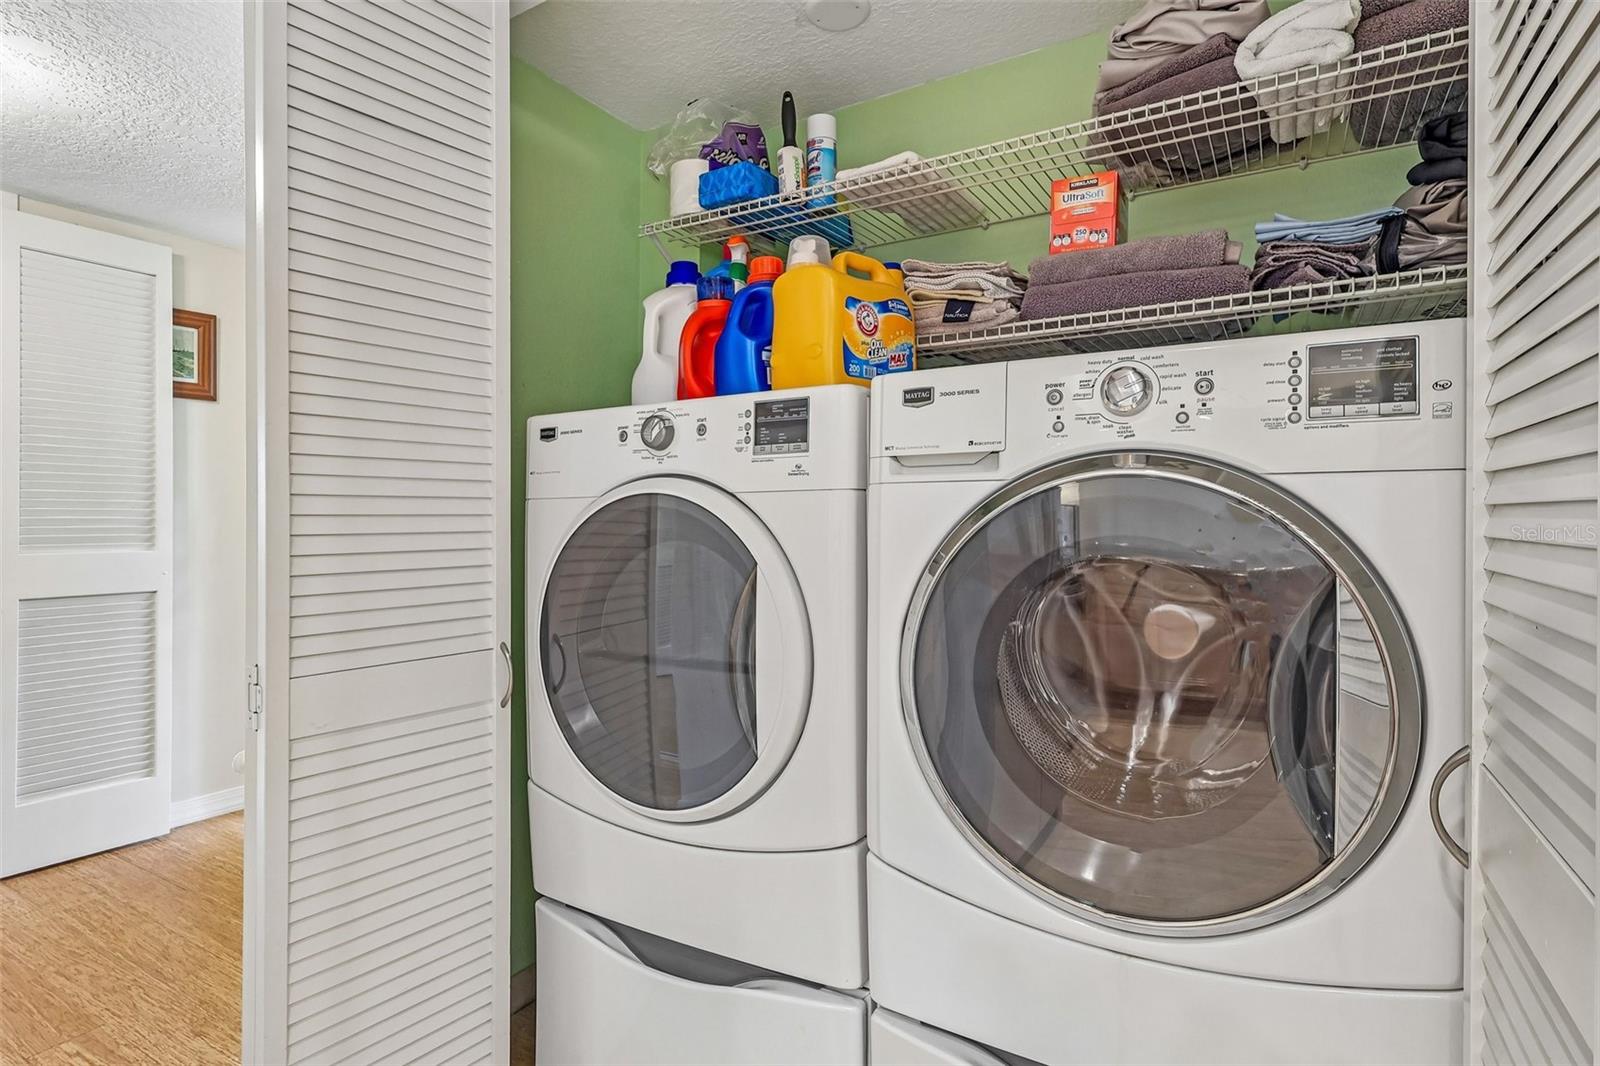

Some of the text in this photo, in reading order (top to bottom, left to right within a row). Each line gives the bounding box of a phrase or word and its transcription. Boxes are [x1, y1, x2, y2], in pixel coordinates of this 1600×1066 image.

[1070, 179, 1098, 188] KIRKLAND
[1062, 188, 1105, 203] UltraSoft
[1075, 228, 1088, 236] 250
[870, 338, 883, 349] OXI
[867, 347, 888, 359] CLEAN
[889, 353, 907, 364] MAX
[849, 364, 860, 372] 200
[1195, 369, 1214, 377] start
[1045, 382, 1066, 390] power
[904, 391, 931, 400] MAYTAG
